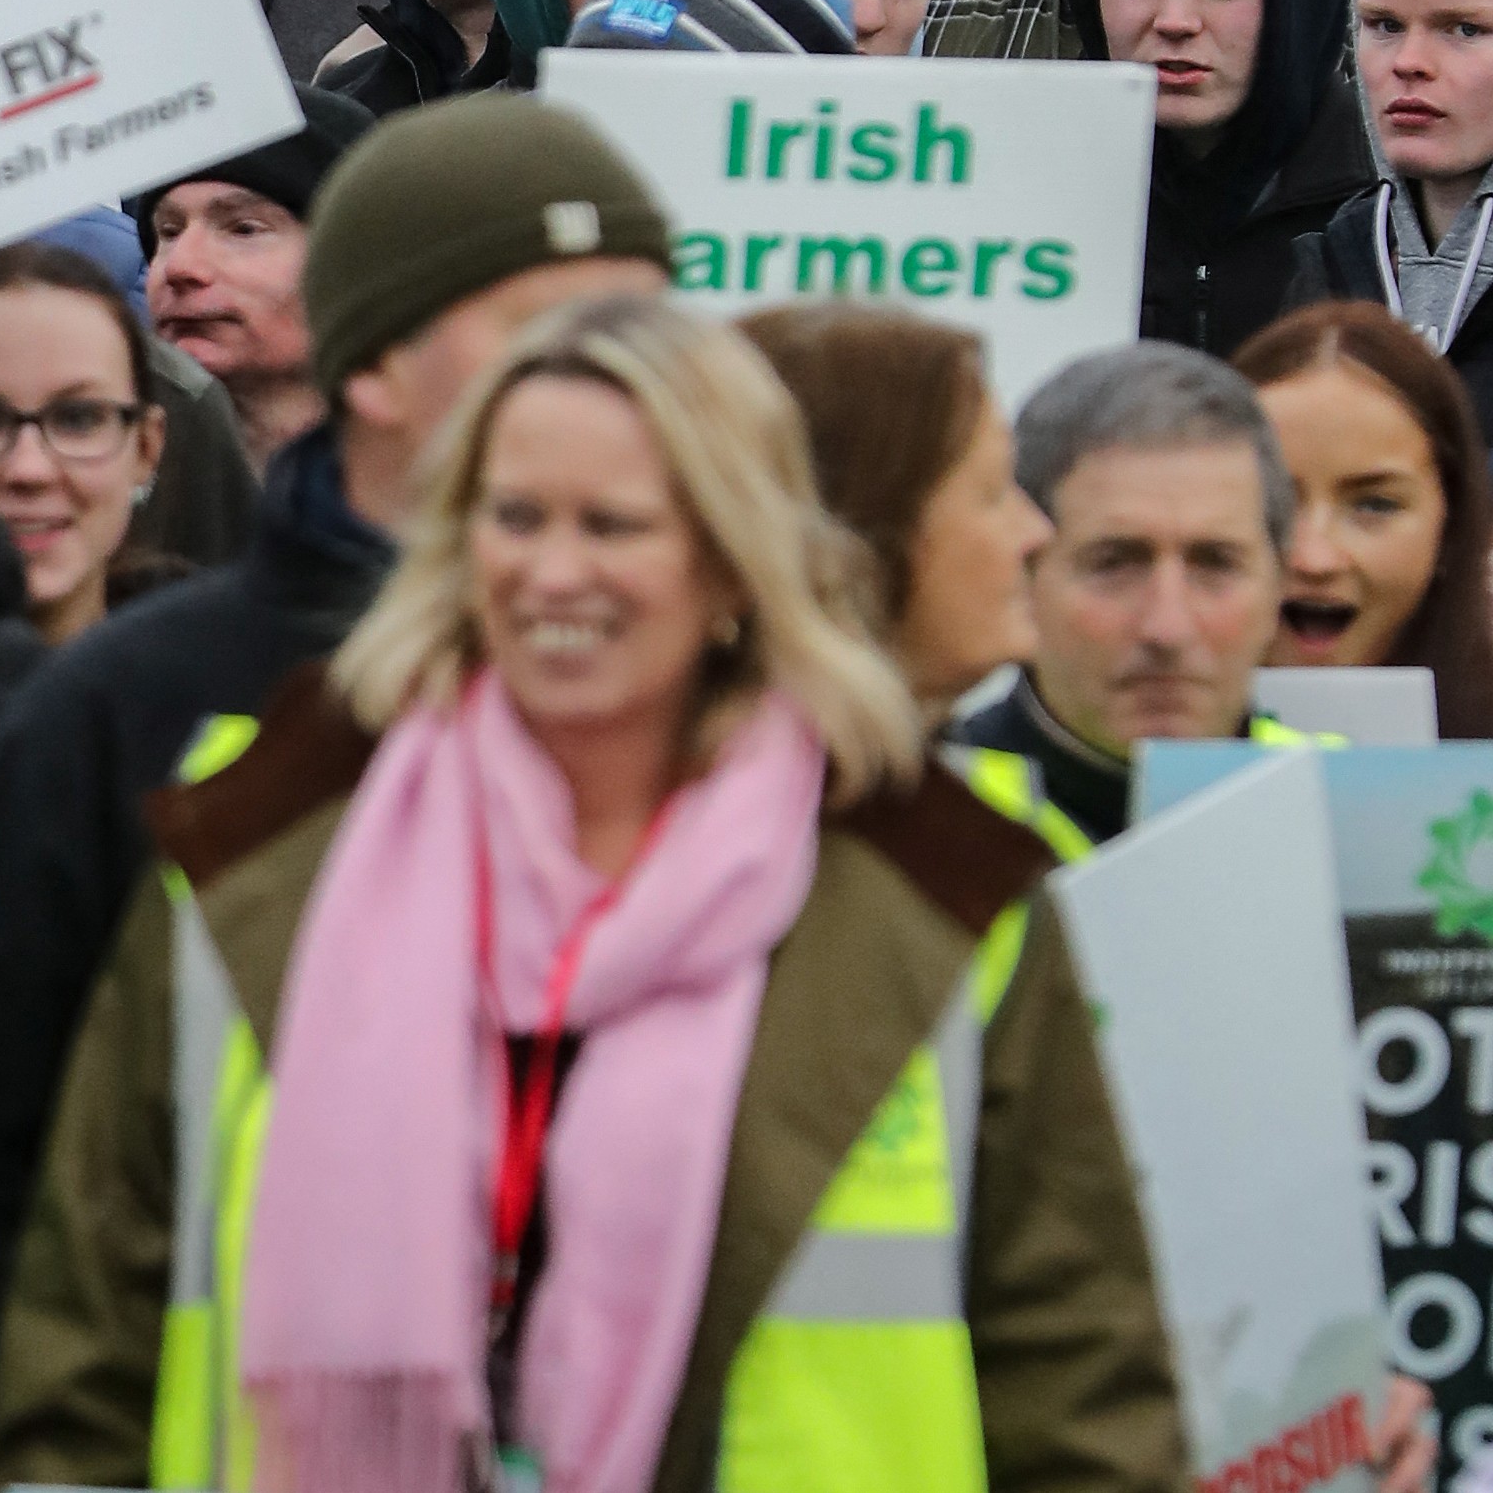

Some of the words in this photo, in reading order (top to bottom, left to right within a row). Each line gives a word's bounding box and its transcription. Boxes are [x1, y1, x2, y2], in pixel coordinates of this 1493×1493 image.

[54, 80, 217, 162] Farmers
[724, 98, 973, 185] Irish
[672, 230, 1076, 301] armers
[1357, 1005, 1493, 1118] OT
